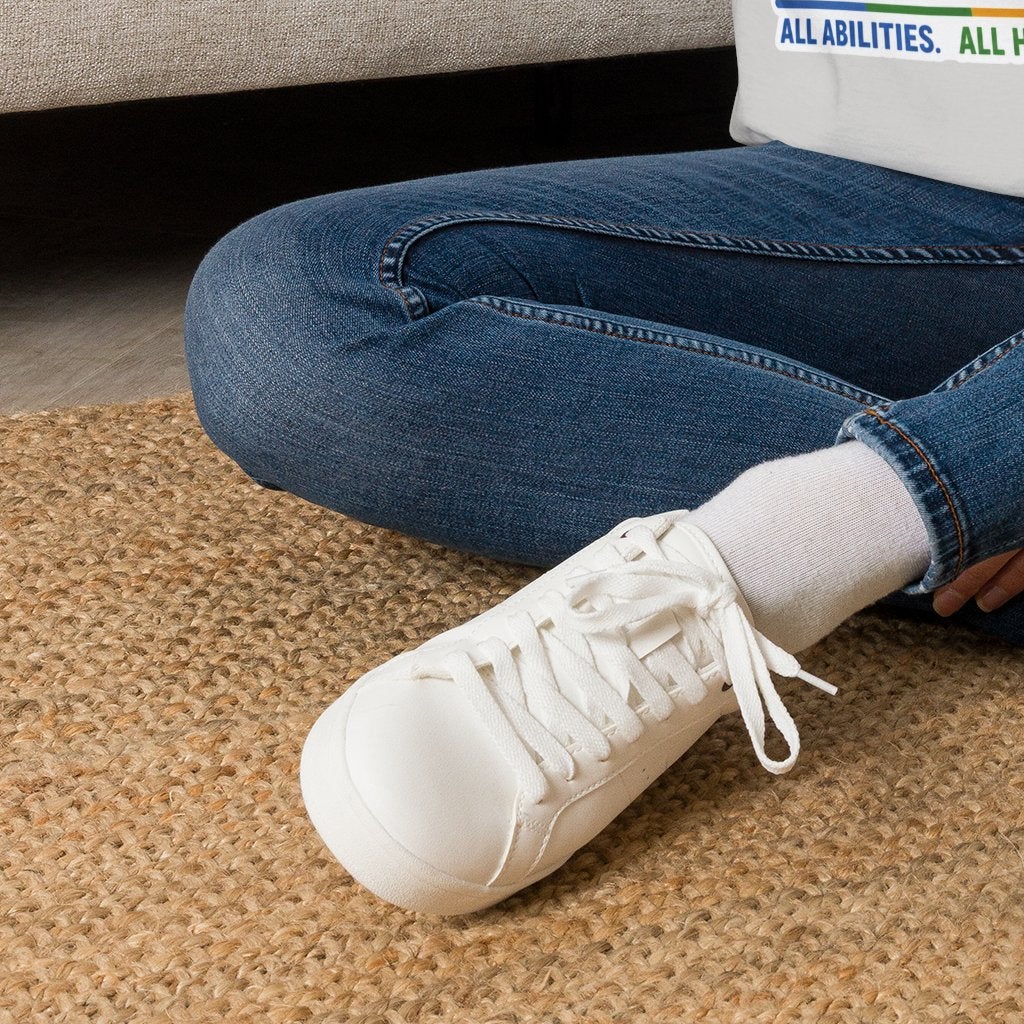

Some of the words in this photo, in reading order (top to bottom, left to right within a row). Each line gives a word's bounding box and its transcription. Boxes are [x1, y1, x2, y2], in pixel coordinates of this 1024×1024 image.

[780, 17, 820, 45] ALL
[822, 19, 941, 55] ABILITIES.
[959, 26, 1004, 56] ALL
